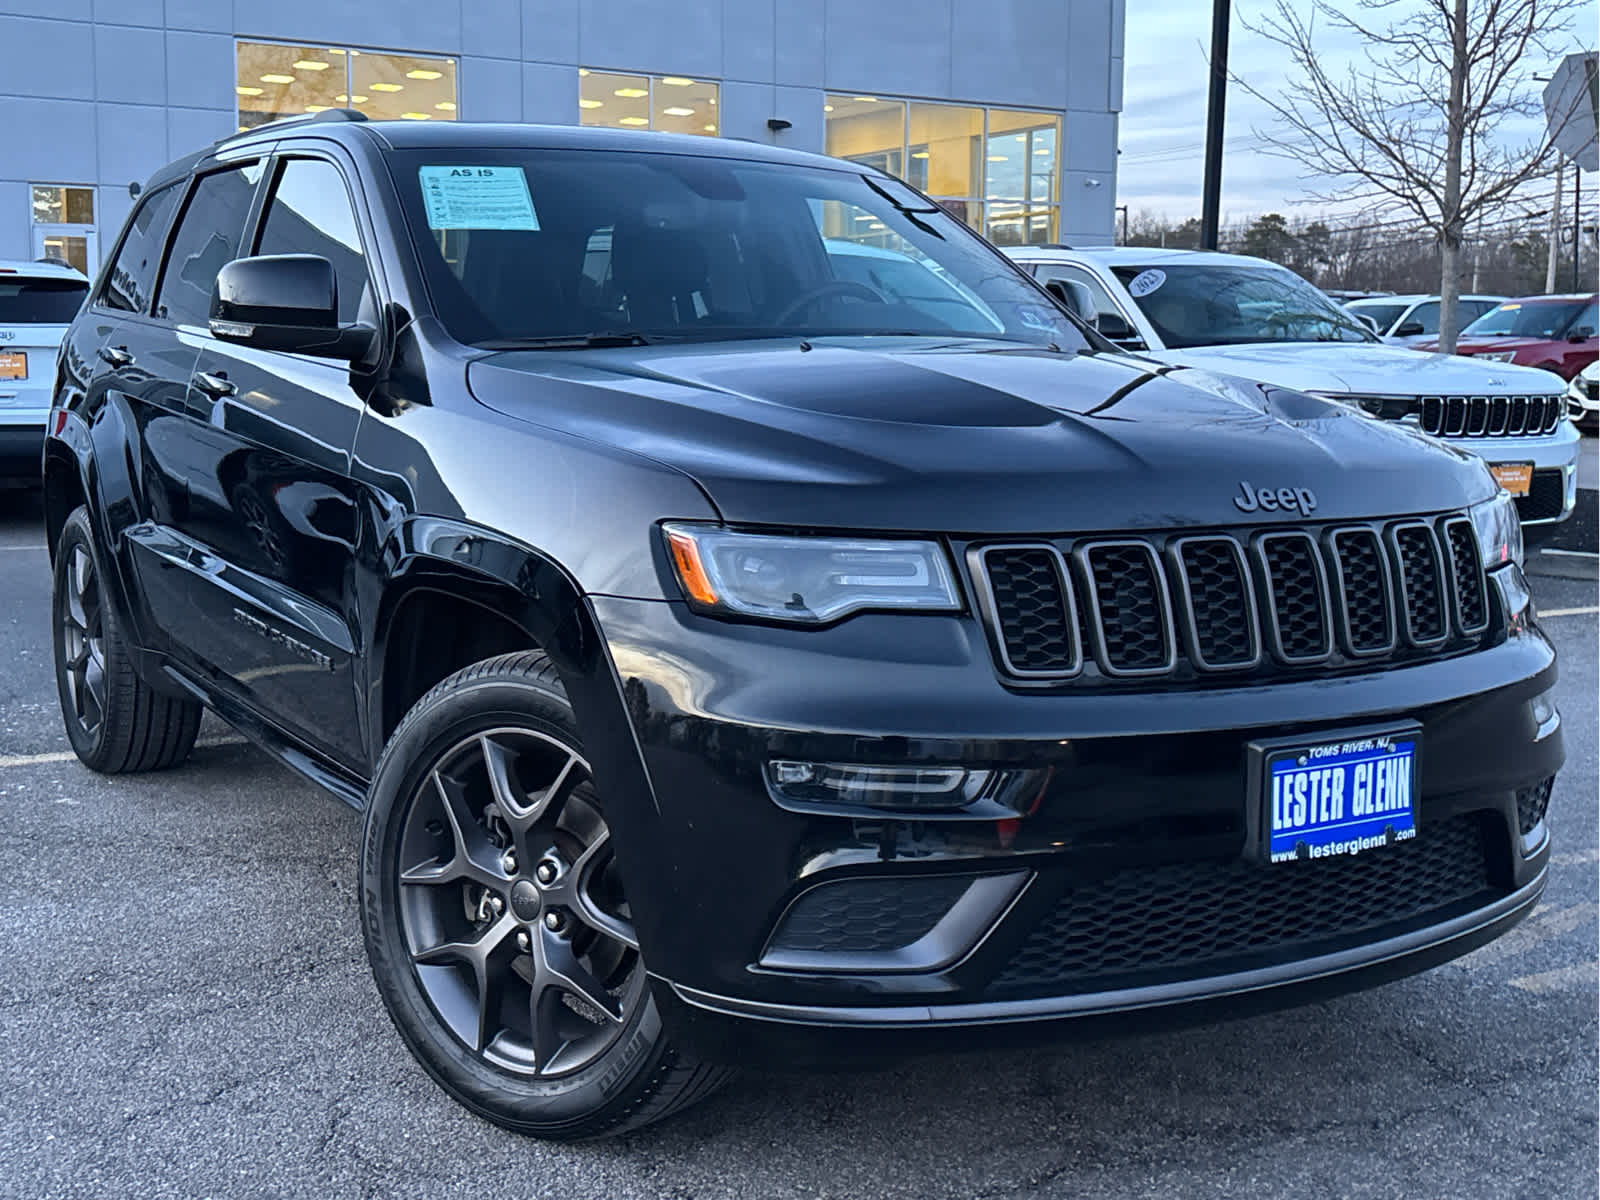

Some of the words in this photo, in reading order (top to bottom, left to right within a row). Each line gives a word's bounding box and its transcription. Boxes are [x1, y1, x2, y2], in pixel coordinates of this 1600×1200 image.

[450, 169, 473, 177] AS
[478, 169, 494, 177] IS
[1232, 481, 1317, 517] Jeep
[1309, 746, 1339, 759] TOMS
[1376, 736, 1390, 748] NJ
[1273, 767, 1345, 830] LESTER
[1352, 756, 1411, 817] GLENN
[1309, 833, 1387, 859] lesterglenn
